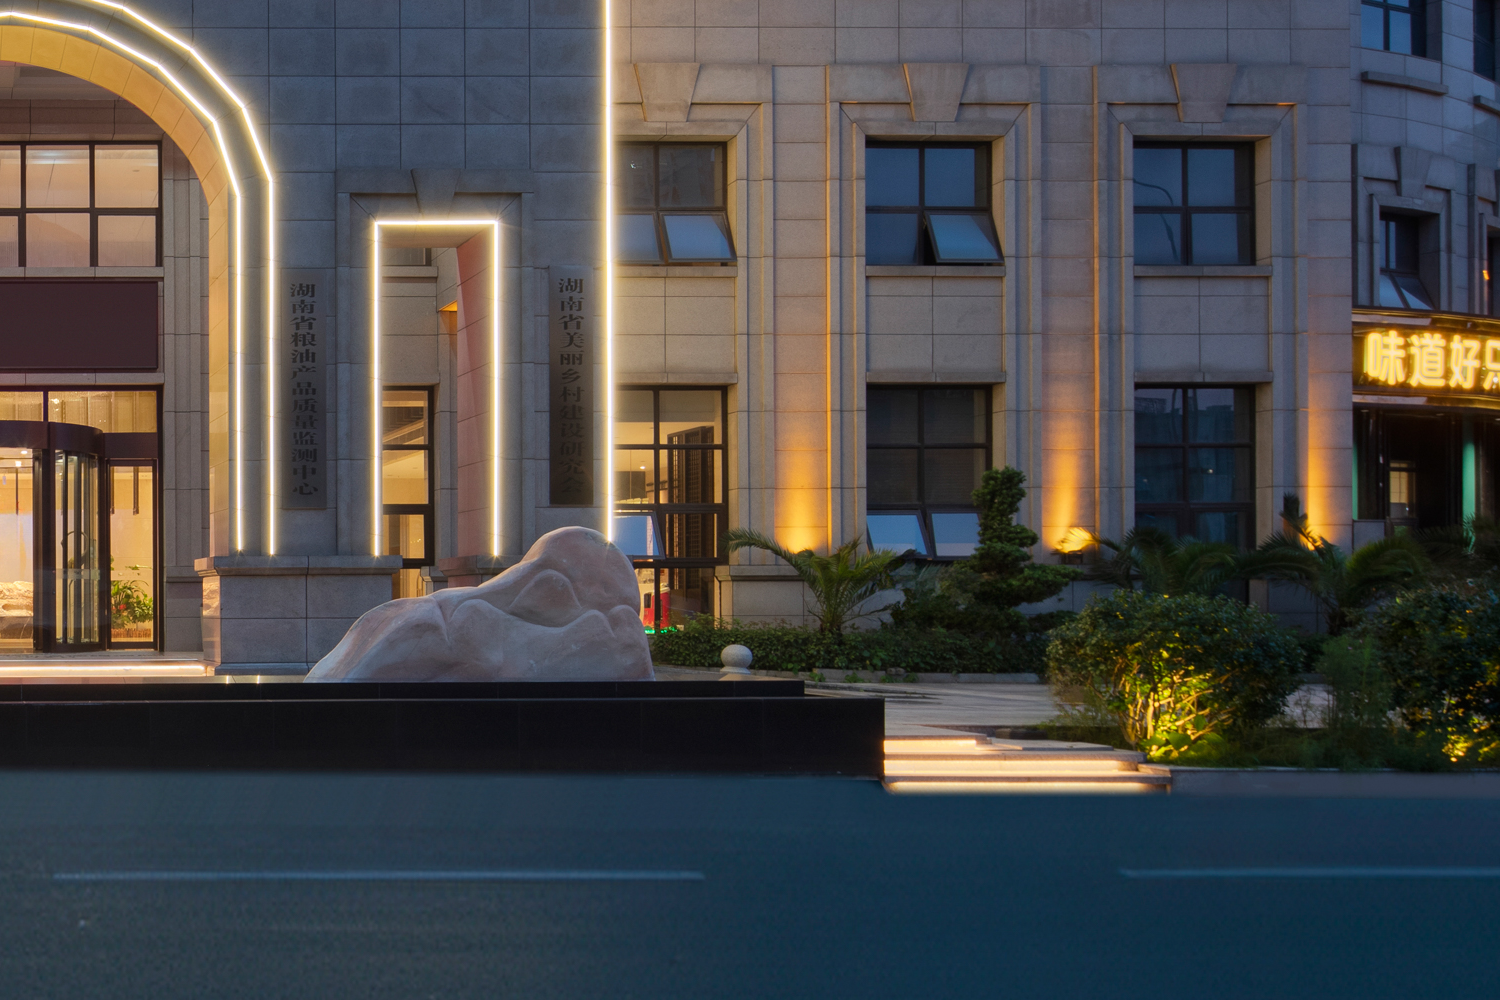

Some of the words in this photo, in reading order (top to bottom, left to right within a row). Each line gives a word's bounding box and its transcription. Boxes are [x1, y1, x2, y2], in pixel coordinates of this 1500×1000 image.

[289, 282, 319, 496] 湖南省粮油产品质量监测中心
[557, 278, 585, 493] 湖南省美丽乡村建设研究会
